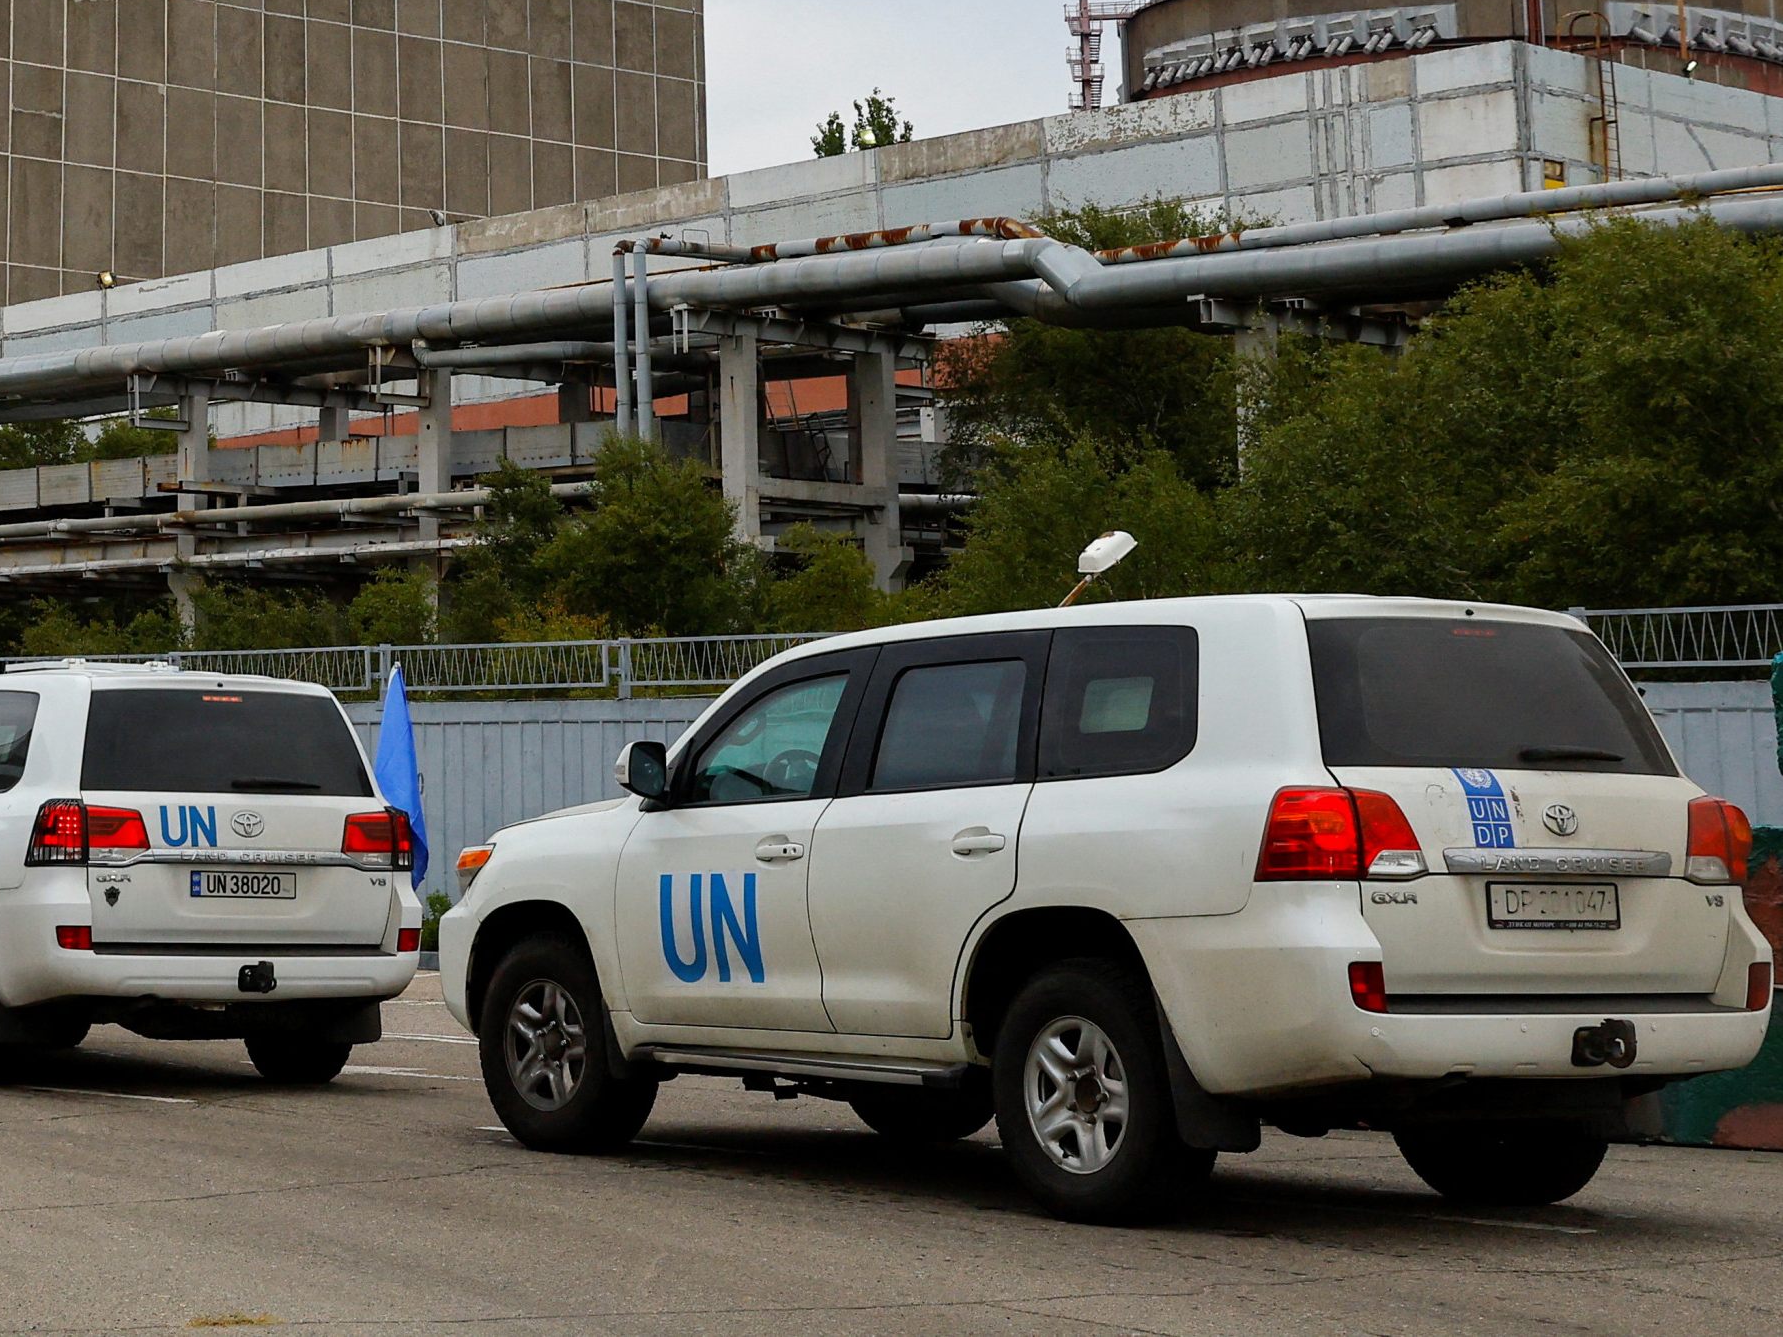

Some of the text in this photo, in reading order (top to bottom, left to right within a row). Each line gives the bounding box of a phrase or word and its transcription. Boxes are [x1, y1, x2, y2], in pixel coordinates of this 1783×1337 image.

[1471, 800, 1506, 819] UN
[160, 805, 218, 847] UN
[1477, 827, 1509, 845] DP
[181, 851, 319, 864] LAND CRUISER
[1481, 855, 1646, 873] LAND CRUISER
[206, 874, 281, 895] UN 38020
[370, 877, 387, 887] V8
[660, 873, 765, 983] UN
